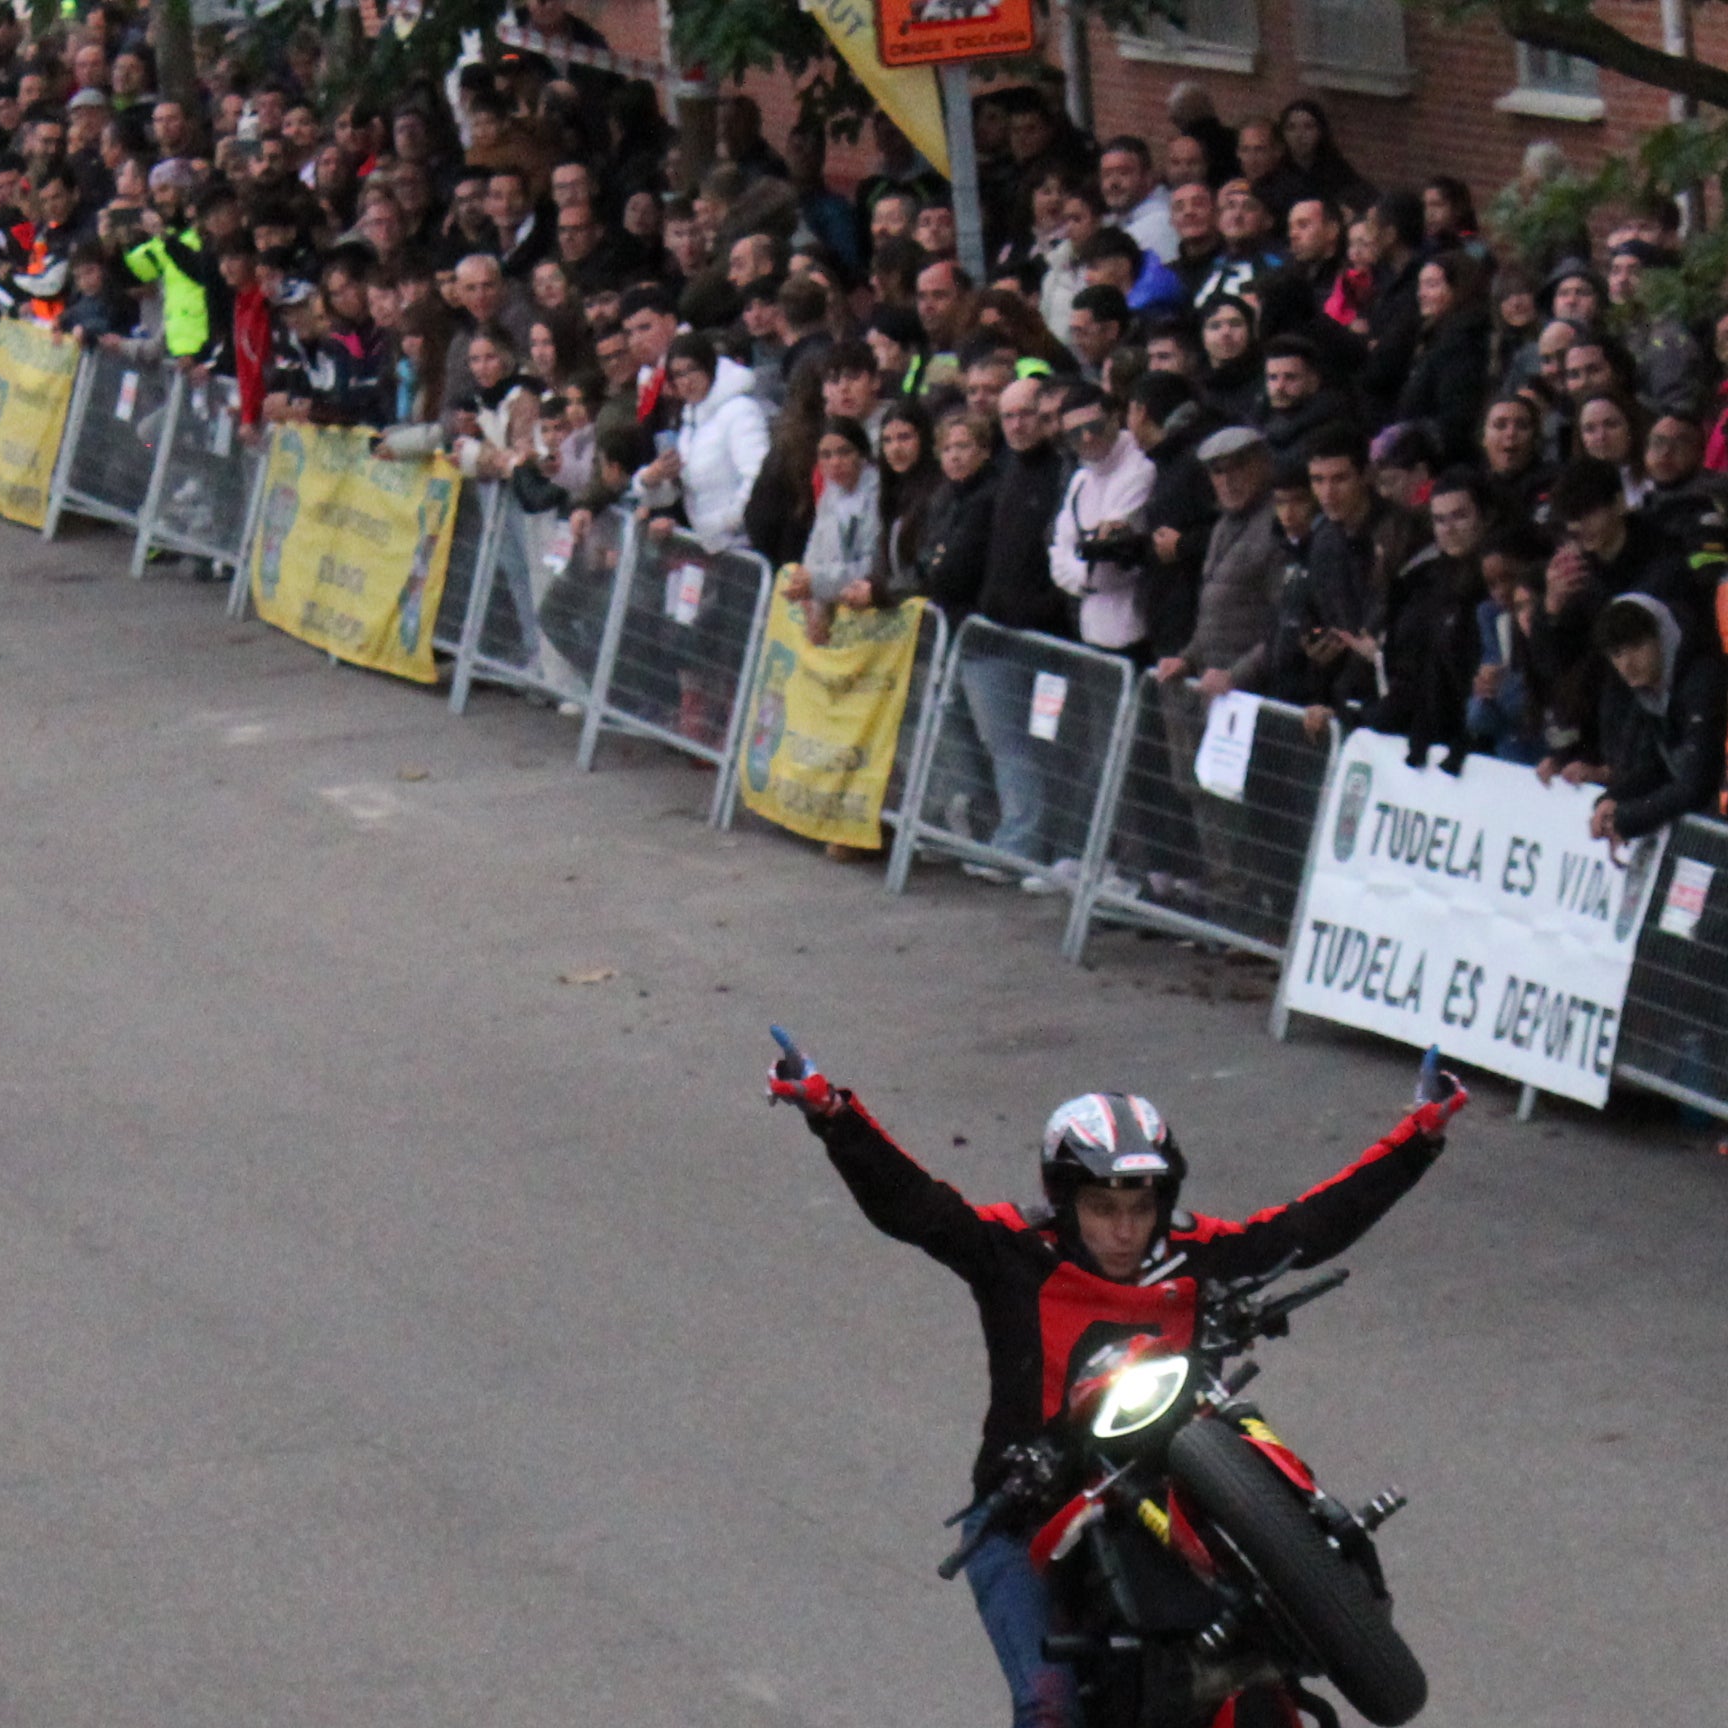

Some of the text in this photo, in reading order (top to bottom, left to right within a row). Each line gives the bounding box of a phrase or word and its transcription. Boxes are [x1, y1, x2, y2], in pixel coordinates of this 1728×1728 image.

[1370, 801, 1485, 883] TUDELA
[1502, 836, 1543, 897] ES
[1557, 852, 1612, 922] VIDA
[1305, 920, 1617, 1078] TUDELA ES DEPORTE
